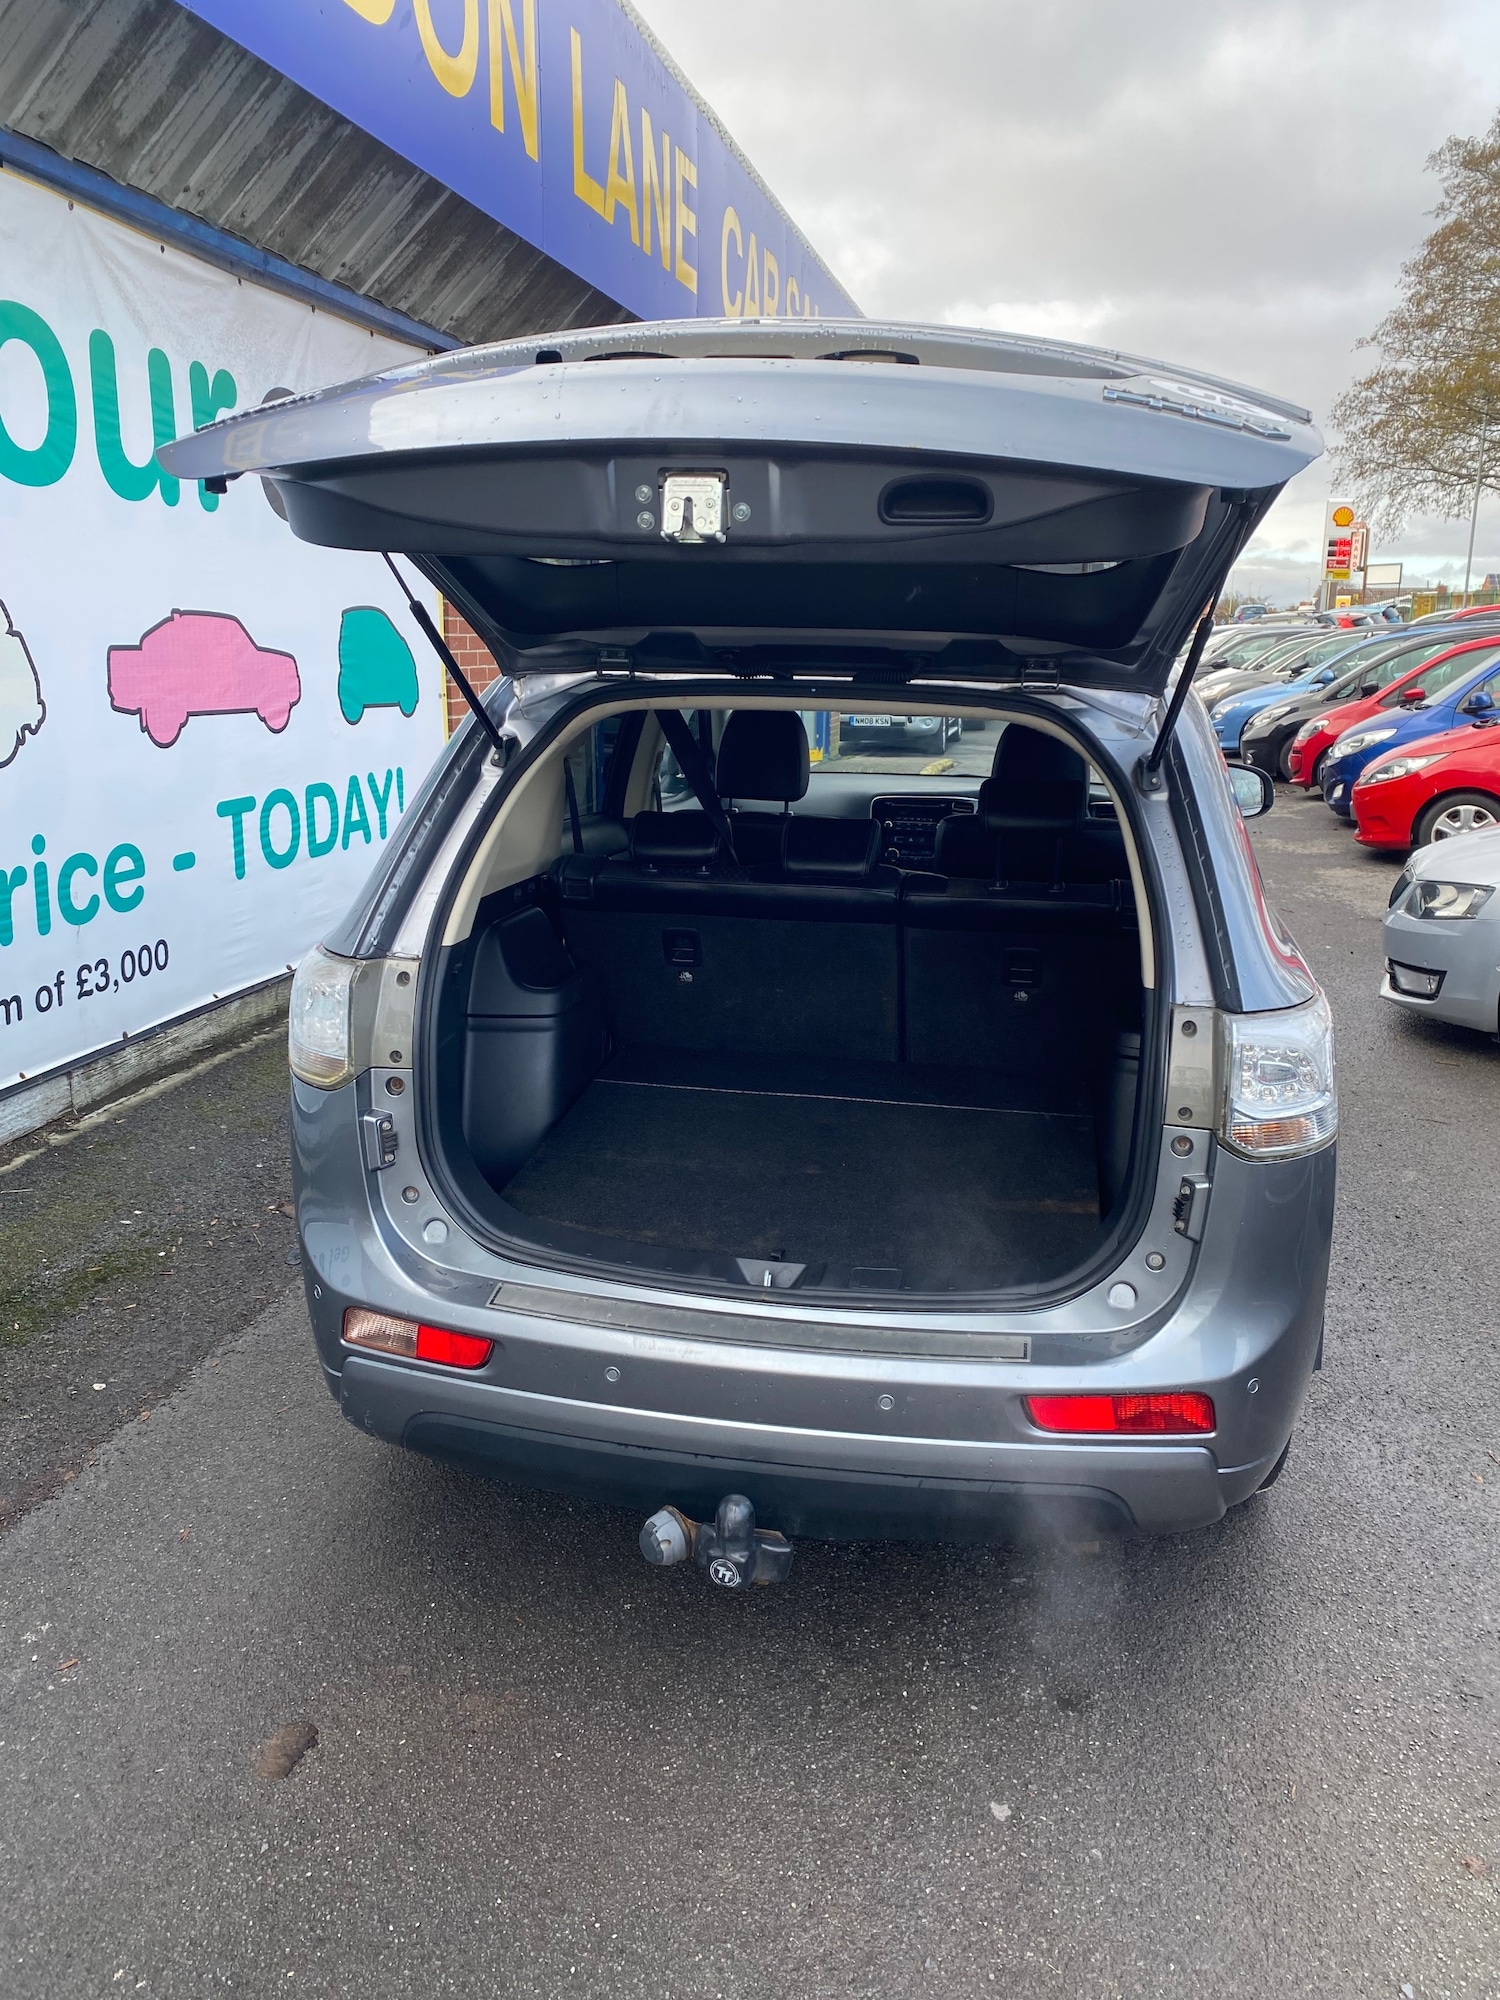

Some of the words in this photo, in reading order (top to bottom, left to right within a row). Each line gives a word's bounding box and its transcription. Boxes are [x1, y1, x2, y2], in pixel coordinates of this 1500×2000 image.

[570, 25, 698, 294] LANE
[721, 206, 779, 318] CAR
[855, 717, 874, 725] NM08
[874, 717, 890, 725] KSN
[216, 766, 404, 880] TODAY!
[35, 970, 66, 1013] of
[76, 938, 169, 1000] £3,000
